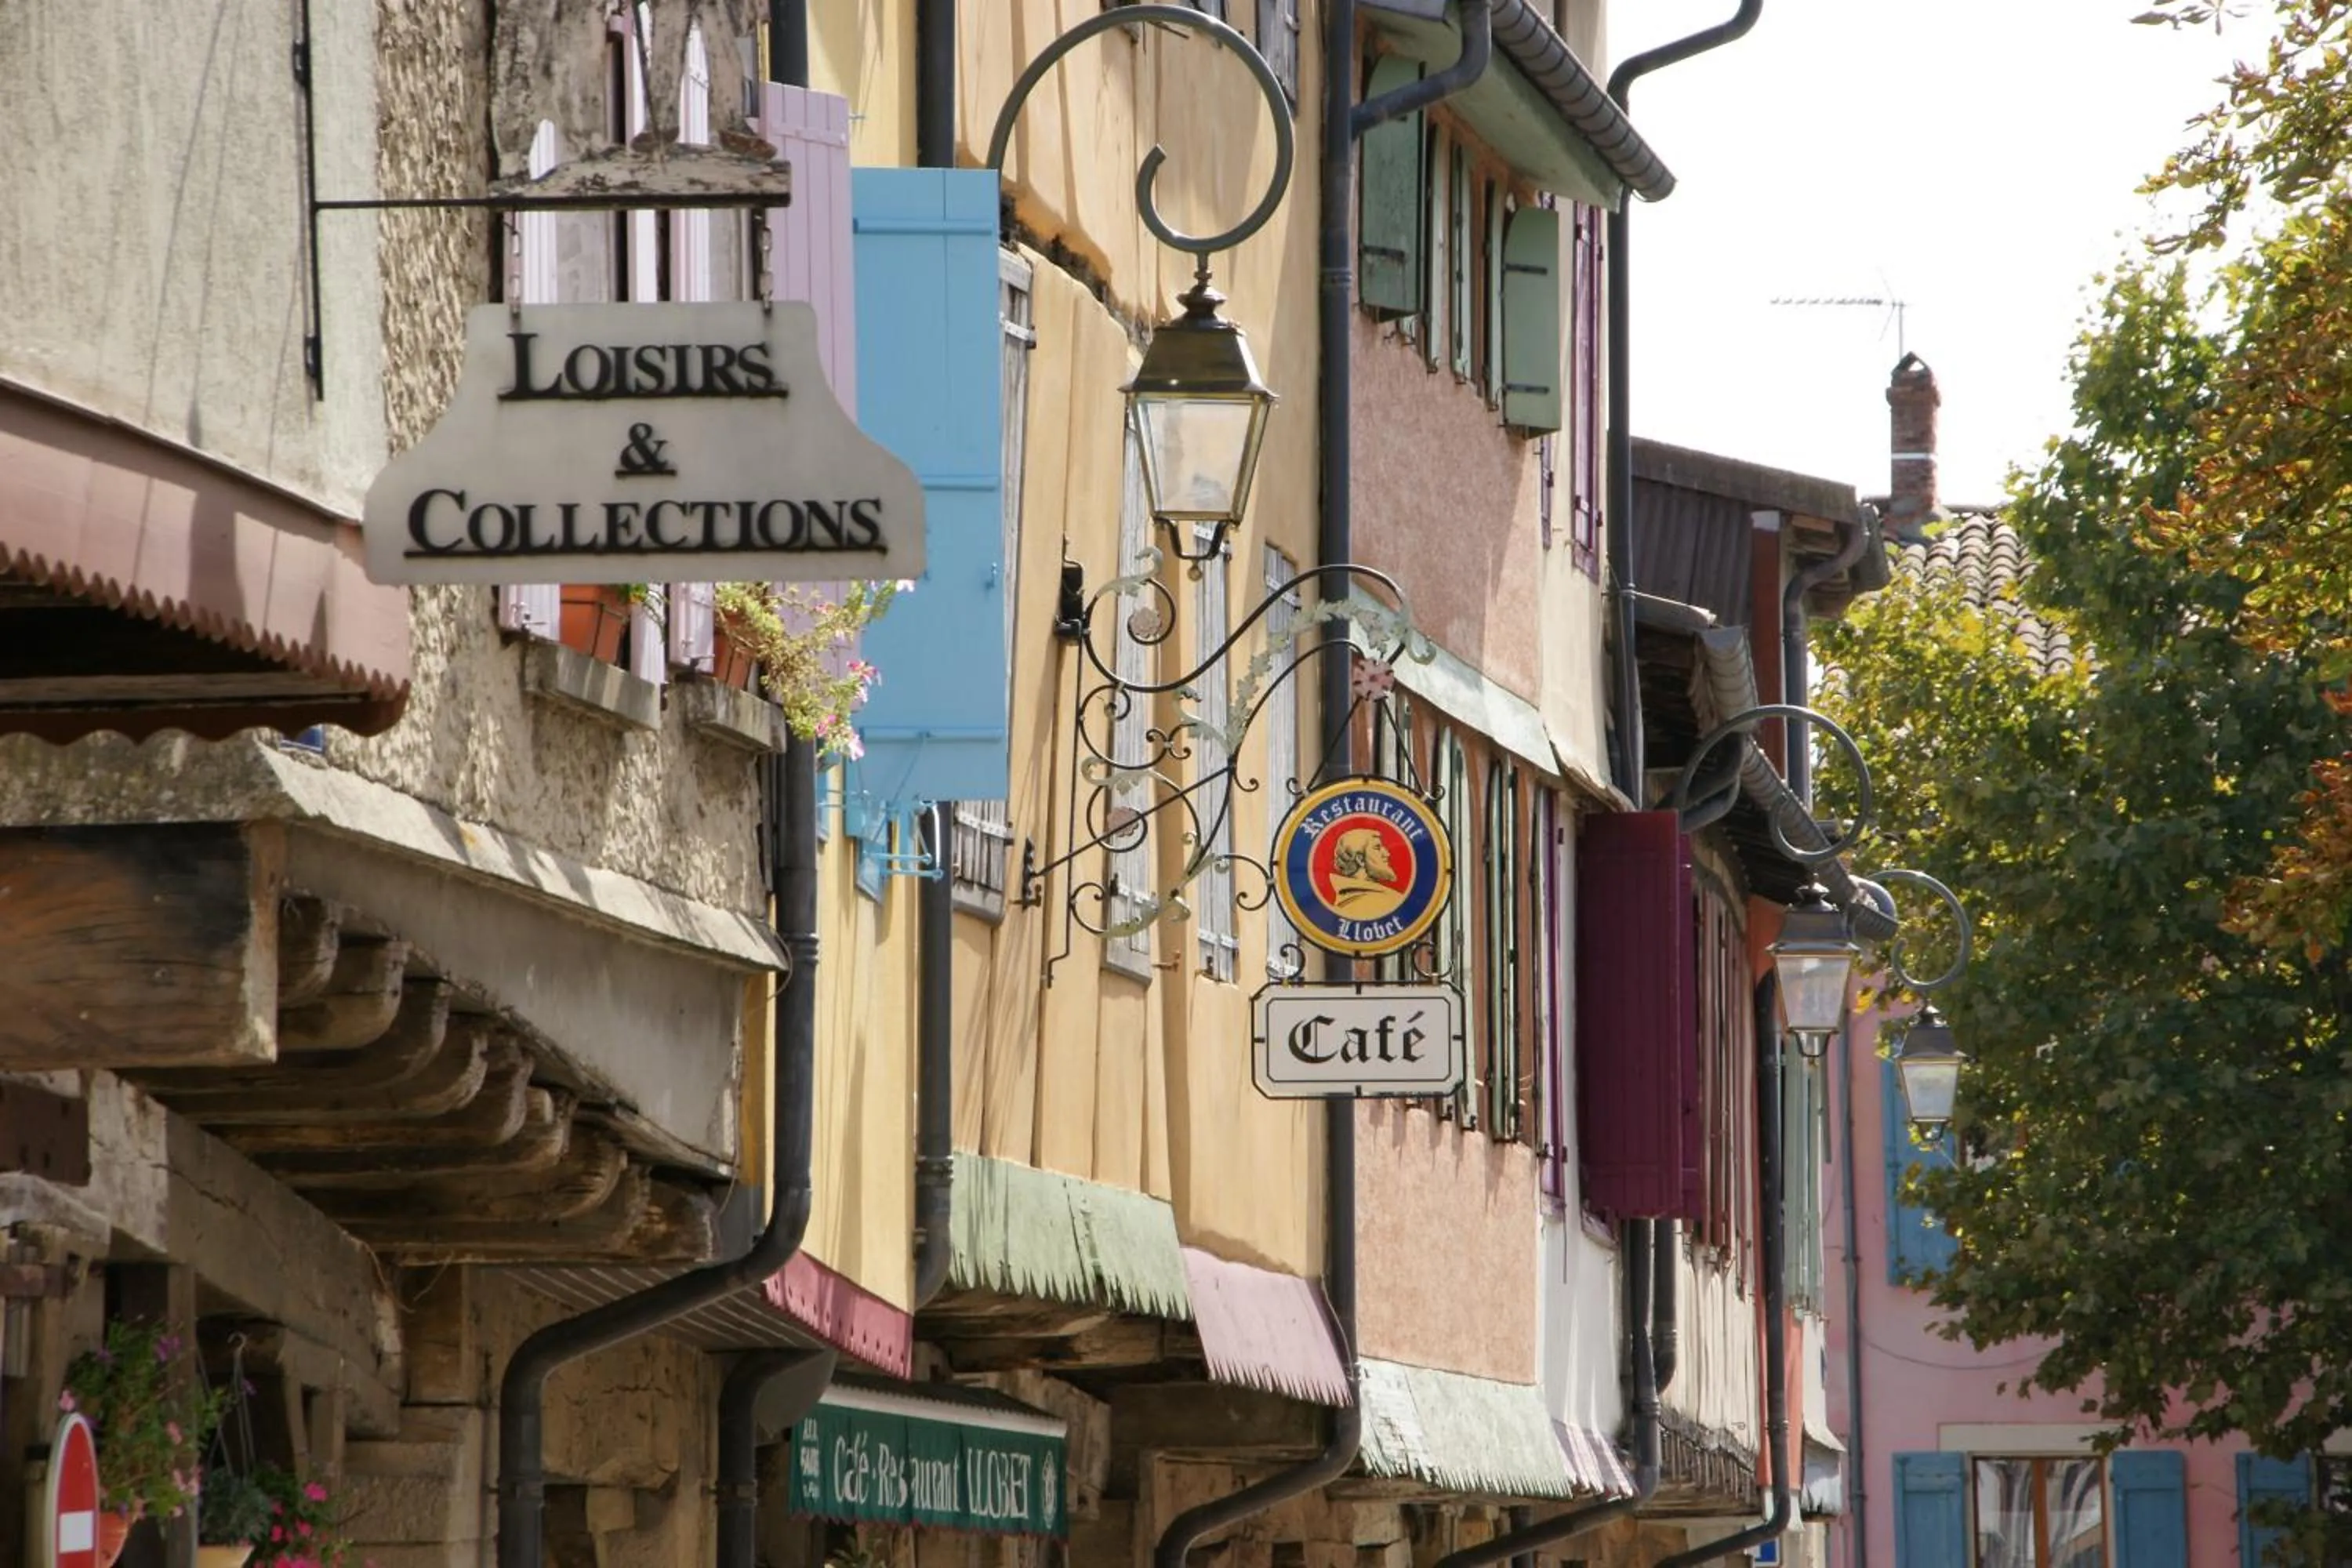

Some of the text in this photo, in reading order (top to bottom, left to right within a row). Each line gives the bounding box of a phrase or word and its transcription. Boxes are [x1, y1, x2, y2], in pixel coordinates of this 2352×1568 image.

[505, 332, 778, 396] LOISIRS
[619, 422, 673, 472] &
[406, 489, 884, 554] COLLECTIONS
[1299, 796, 1425, 840] Restaurant
[1338, 916, 1403, 942] Llobet
[1288, 1010, 1426, 1065] Café
[877, 1443, 960, 1512] Resaurant
[967, 1446, 1032, 1519] LLOBET
